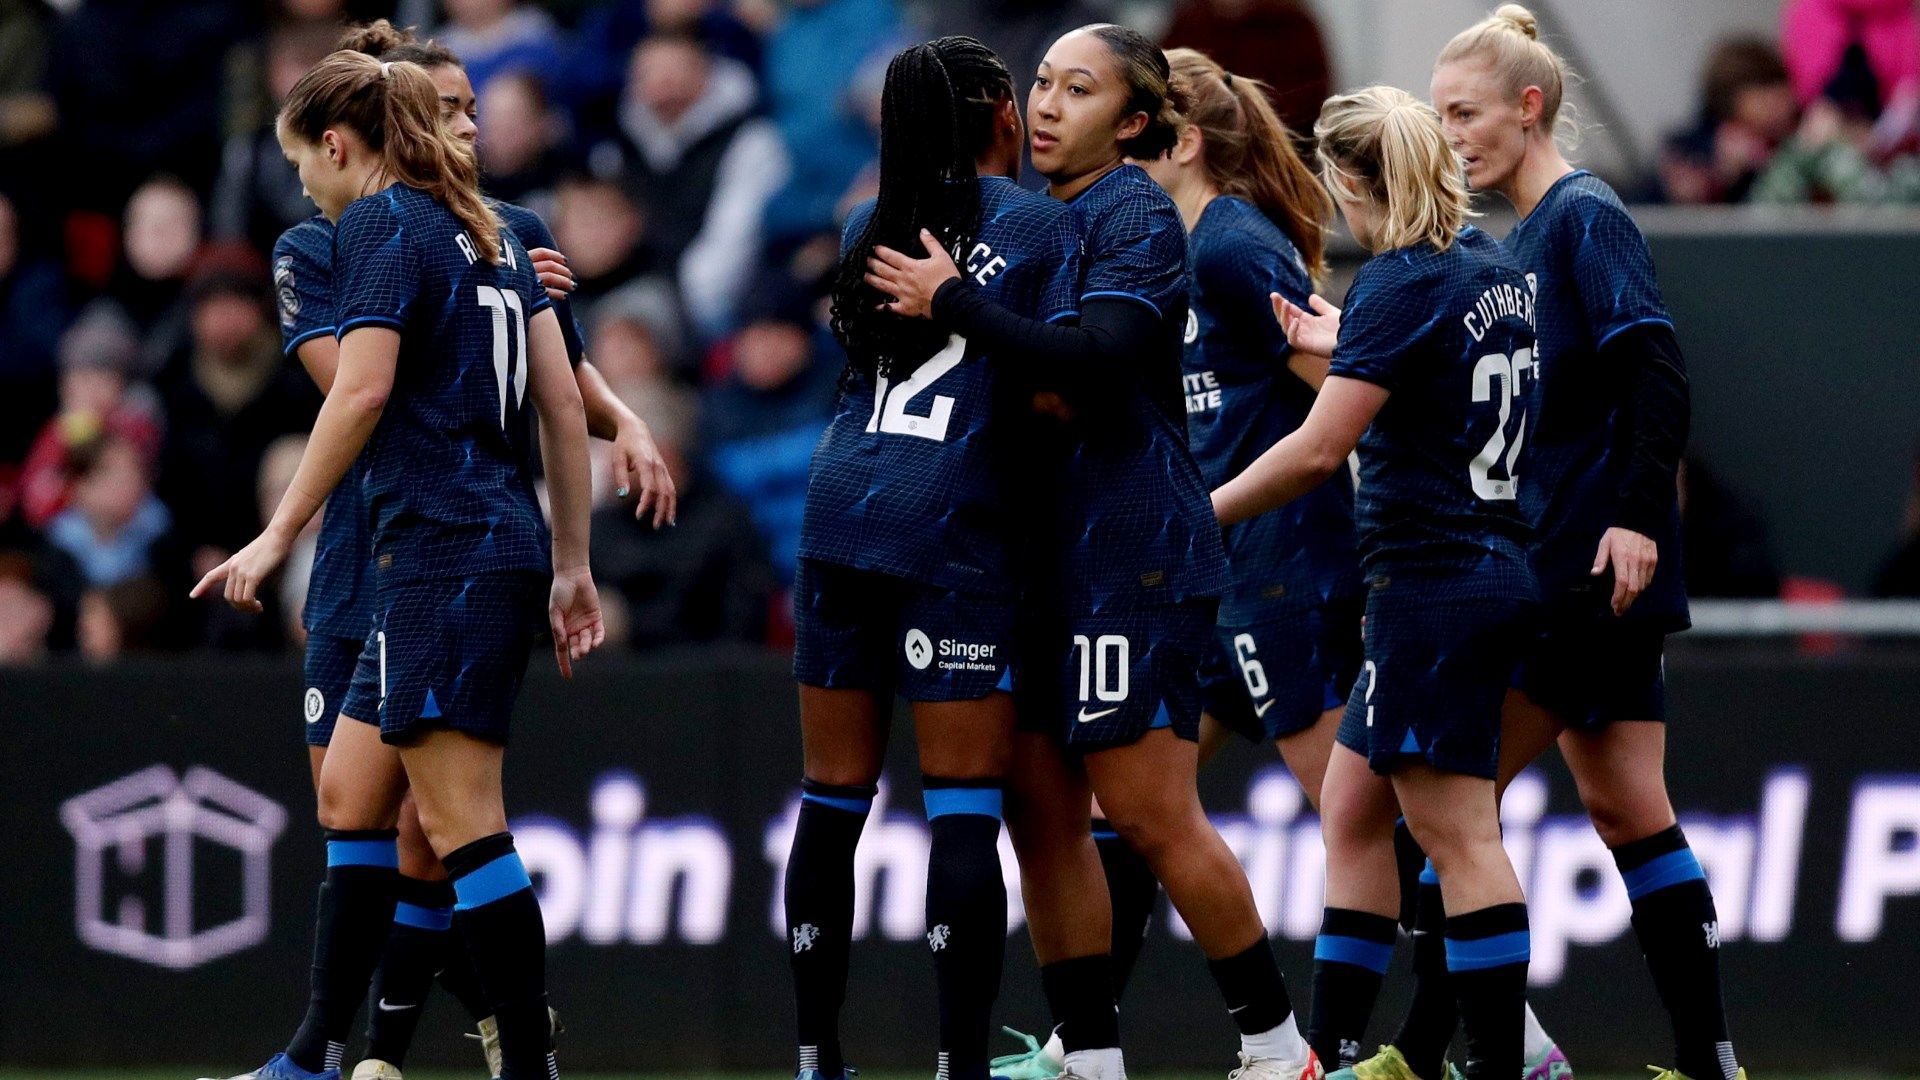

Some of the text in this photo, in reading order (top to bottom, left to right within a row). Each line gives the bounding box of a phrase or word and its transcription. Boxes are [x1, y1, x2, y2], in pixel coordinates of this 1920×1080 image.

[476, 286, 527, 431] 11
[865, 332, 966, 441] 12
[938, 661, 965, 670] Capital
[939, 639, 996, 661] Singer
[967, 662, 996, 671] Markets
[1074, 635, 1129, 701] 10
[1234, 633, 1269, 698] 6
